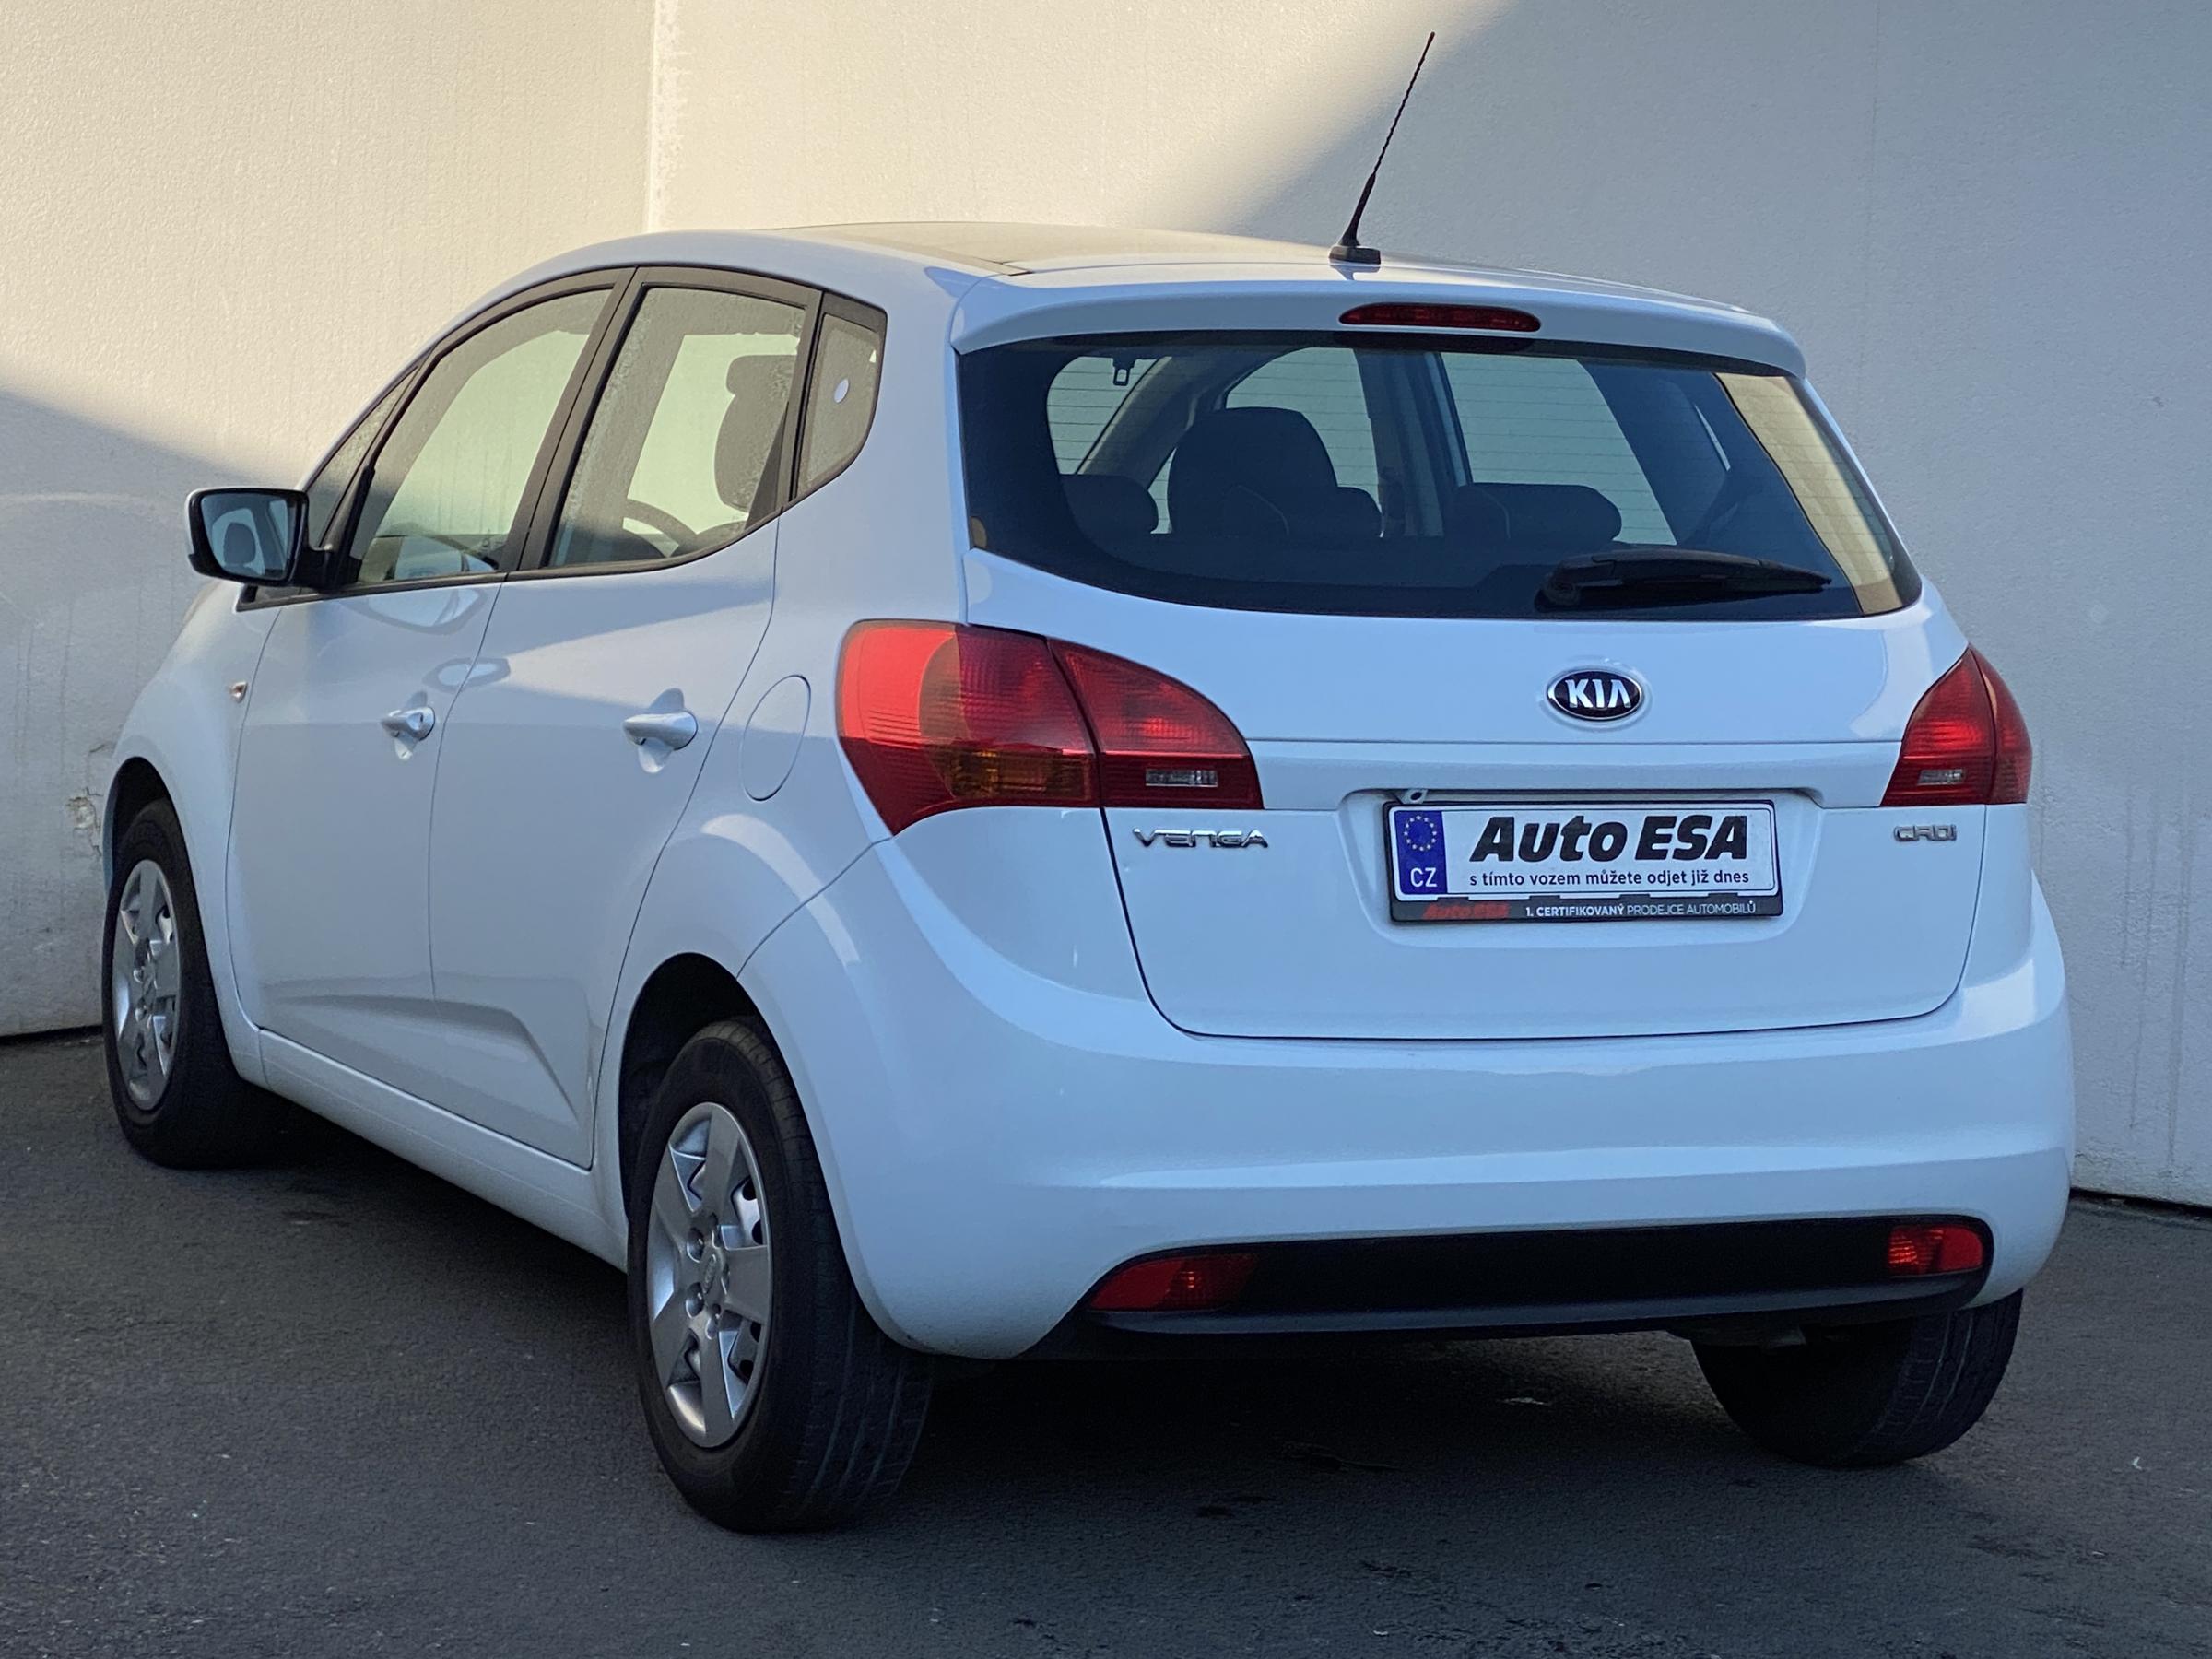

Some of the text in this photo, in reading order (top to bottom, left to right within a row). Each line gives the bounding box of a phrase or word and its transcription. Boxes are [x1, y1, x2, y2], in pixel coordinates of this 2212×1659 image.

[1565, 678, 1631, 708] KIA
[1469, 815, 1747, 863] Auto ESA
[1410, 867, 1437, 888] CZ
[1469, 869, 1749, 887] s tímto vozem můžete odjet již dnes
[1525, 900, 1756, 917] 1. CERTIFIKOVANÝ PRODEJCE AUTOMOBILŮ
